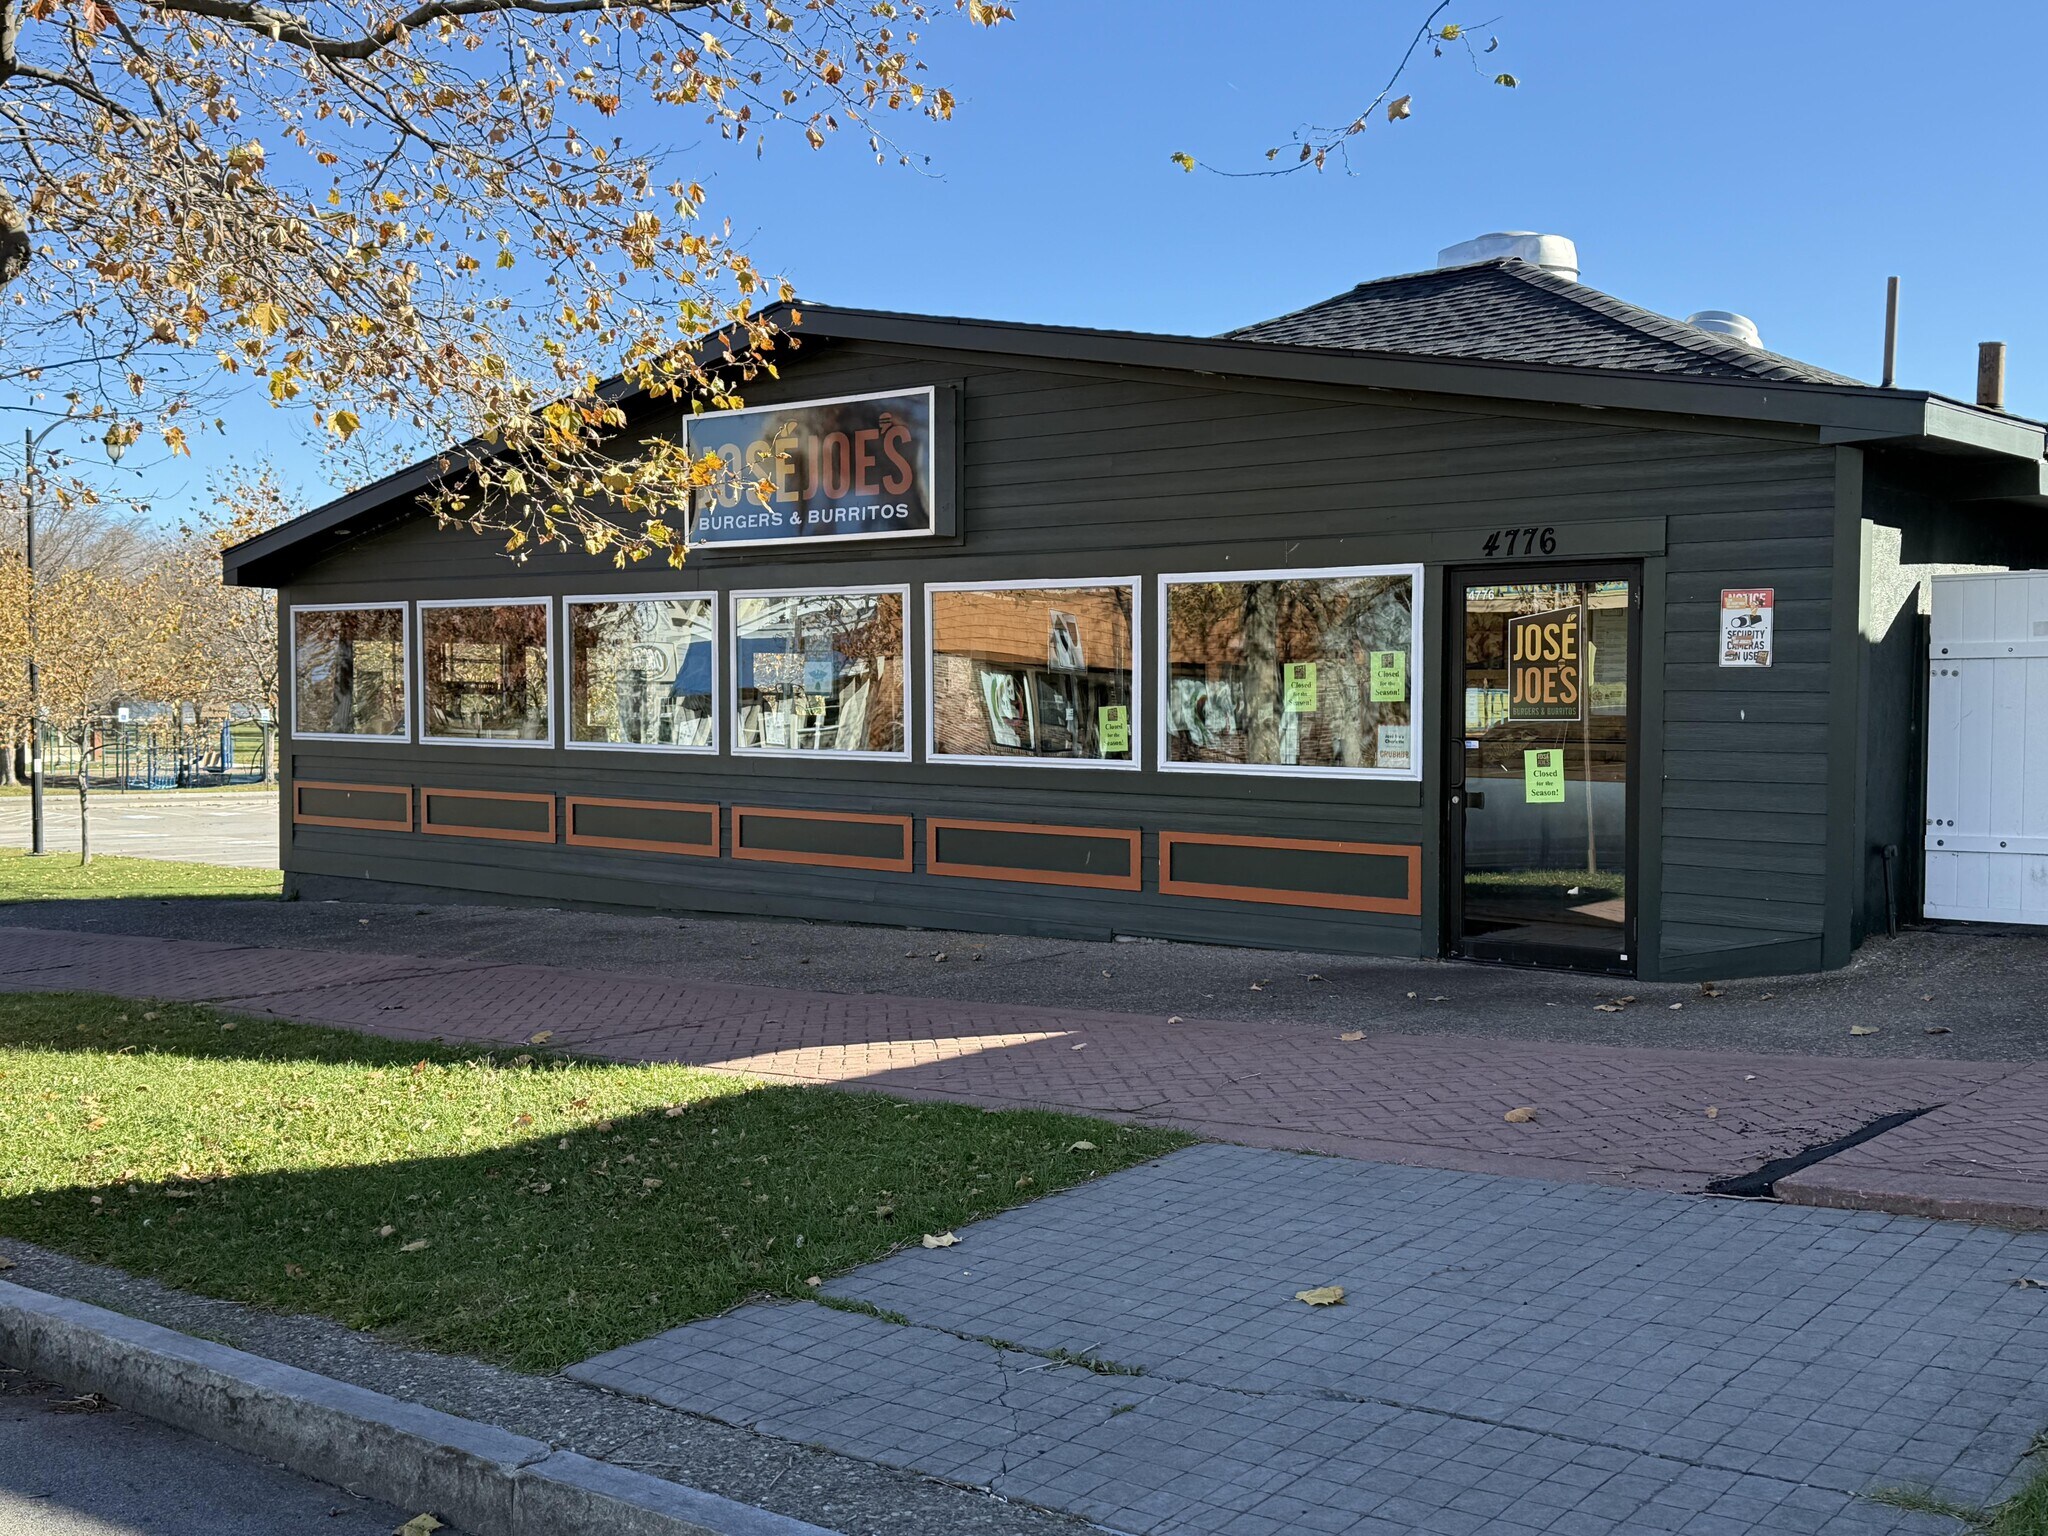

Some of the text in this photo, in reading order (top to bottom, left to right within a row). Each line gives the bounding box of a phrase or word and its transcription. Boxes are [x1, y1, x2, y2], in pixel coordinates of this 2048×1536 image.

[699, 503, 910, 531] BURGERS & BURRITOS
[1482, 528, 1556, 557] 4776
[1468, 590, 1495, 601] 4776
[1513, 613, 1577, 661] JOSÉ
[1377, 670, 1400, 678] Closed
[1512, 707, 1577, 716] BURGERS & BURRITOS
[1531, 789, 1559, 797] Season!
